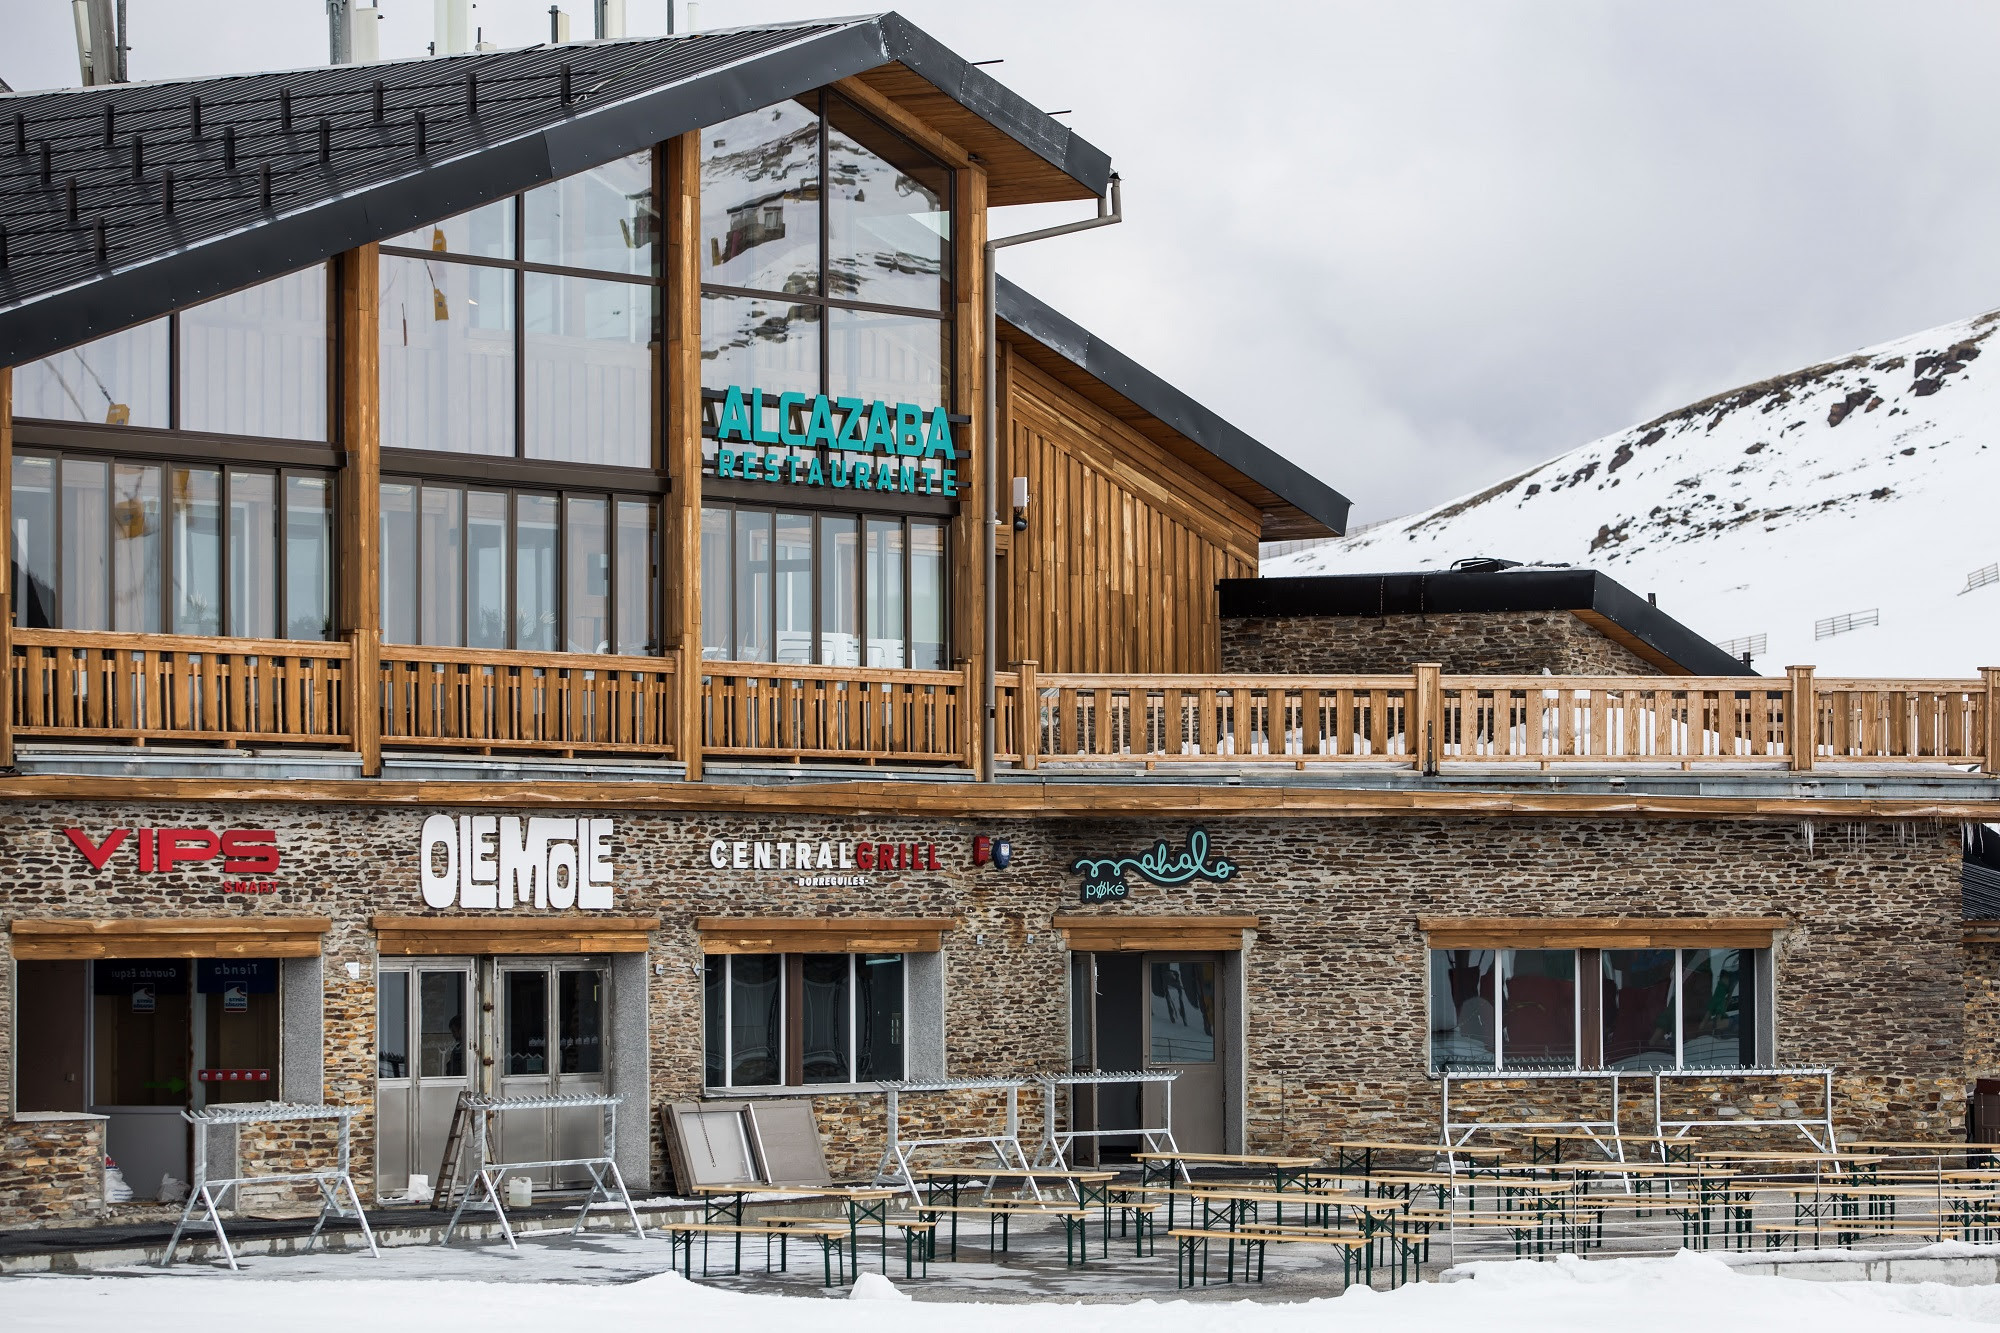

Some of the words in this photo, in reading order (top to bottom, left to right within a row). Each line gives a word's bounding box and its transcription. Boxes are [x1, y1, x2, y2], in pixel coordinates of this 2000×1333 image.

[718, 385, 956, 460] ALCAZABA
[718, 449, 957, 496] RESTAURANTE
[63, 828, 280, 872] VIPS
[1075, 830, 1236, 883] mahalo
[223, 881, 279, 893] SMART
